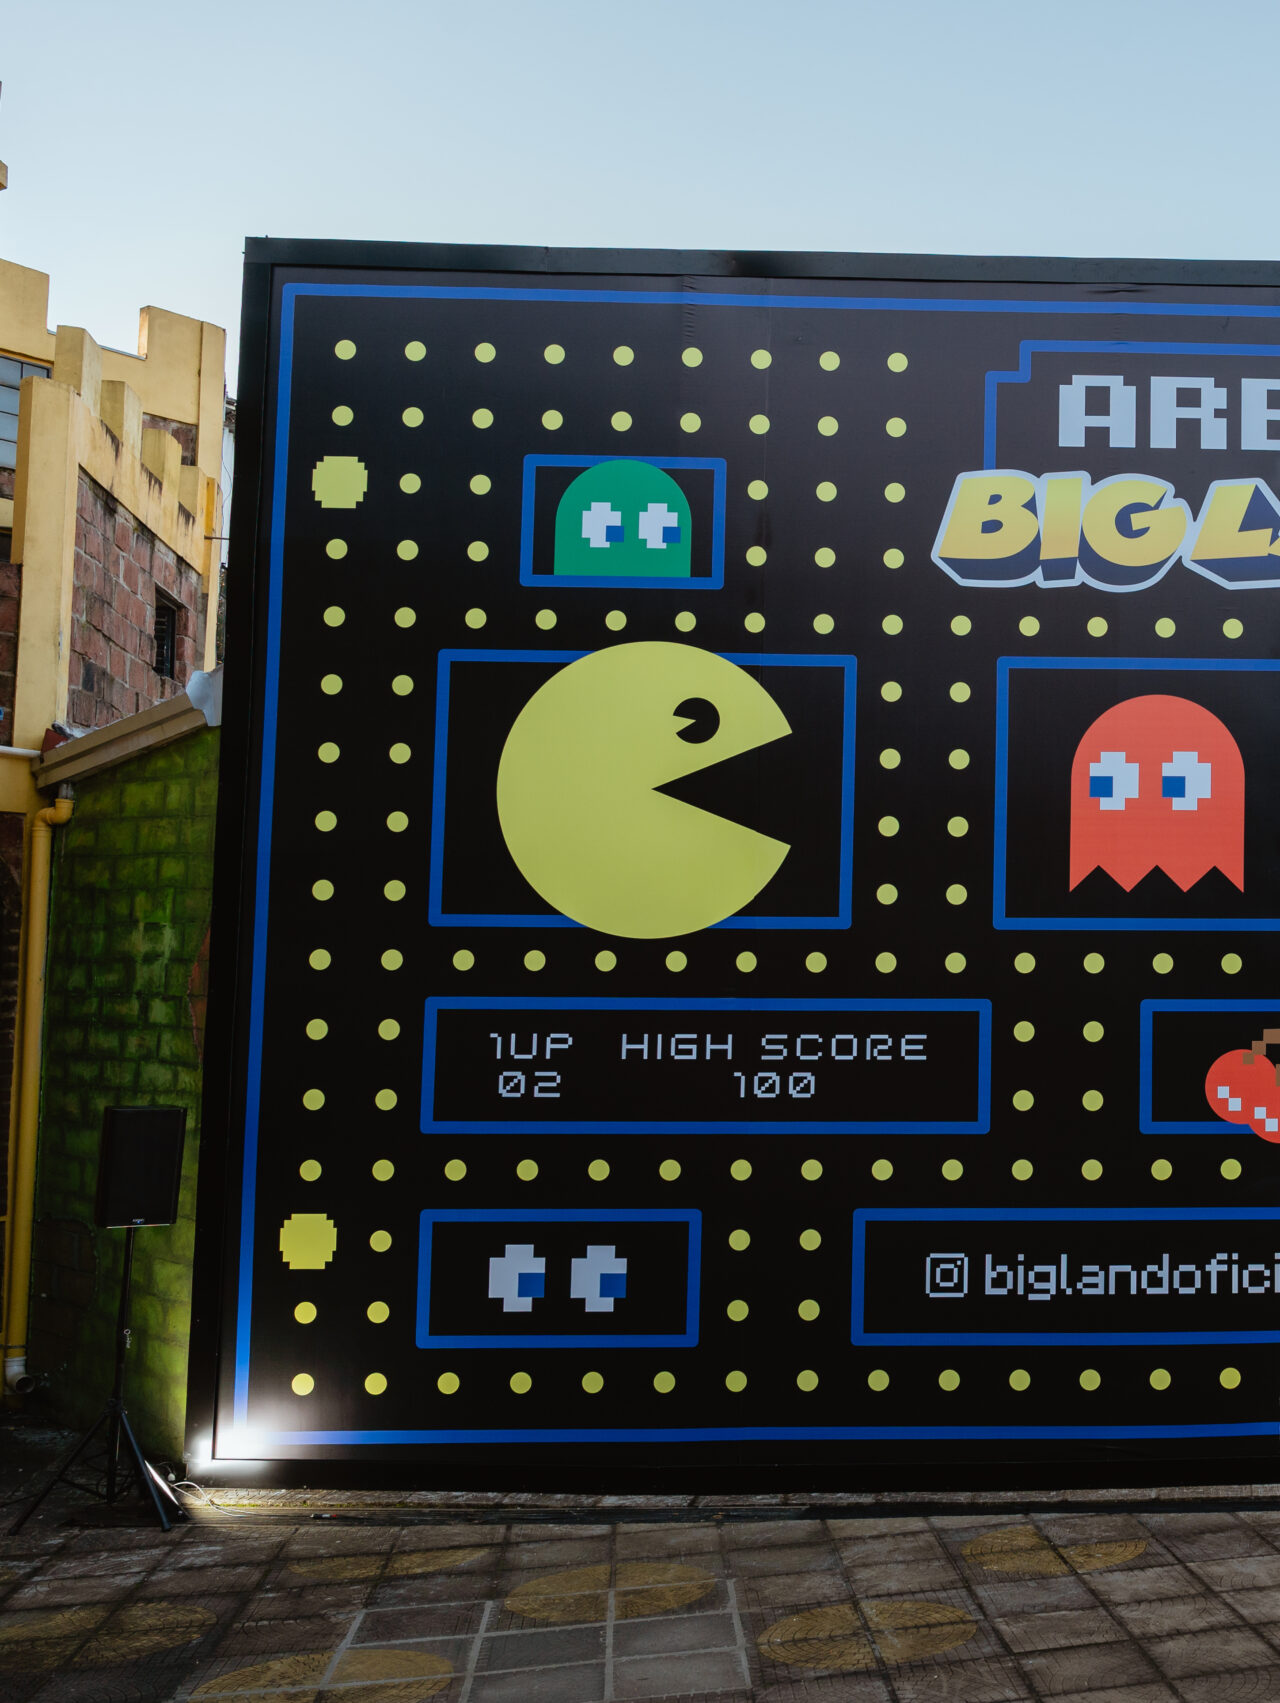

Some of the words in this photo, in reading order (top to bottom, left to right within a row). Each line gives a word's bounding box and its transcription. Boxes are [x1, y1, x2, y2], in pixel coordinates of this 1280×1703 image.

[489, 1033, 574, 1060] 1UP
[621, 1033, 734, 1060] HIGH
[761, 1034, 928, 1060] SCORE
[498, 1071, 561, 1098] 02
[733, 1072, 815, 1098] 100
